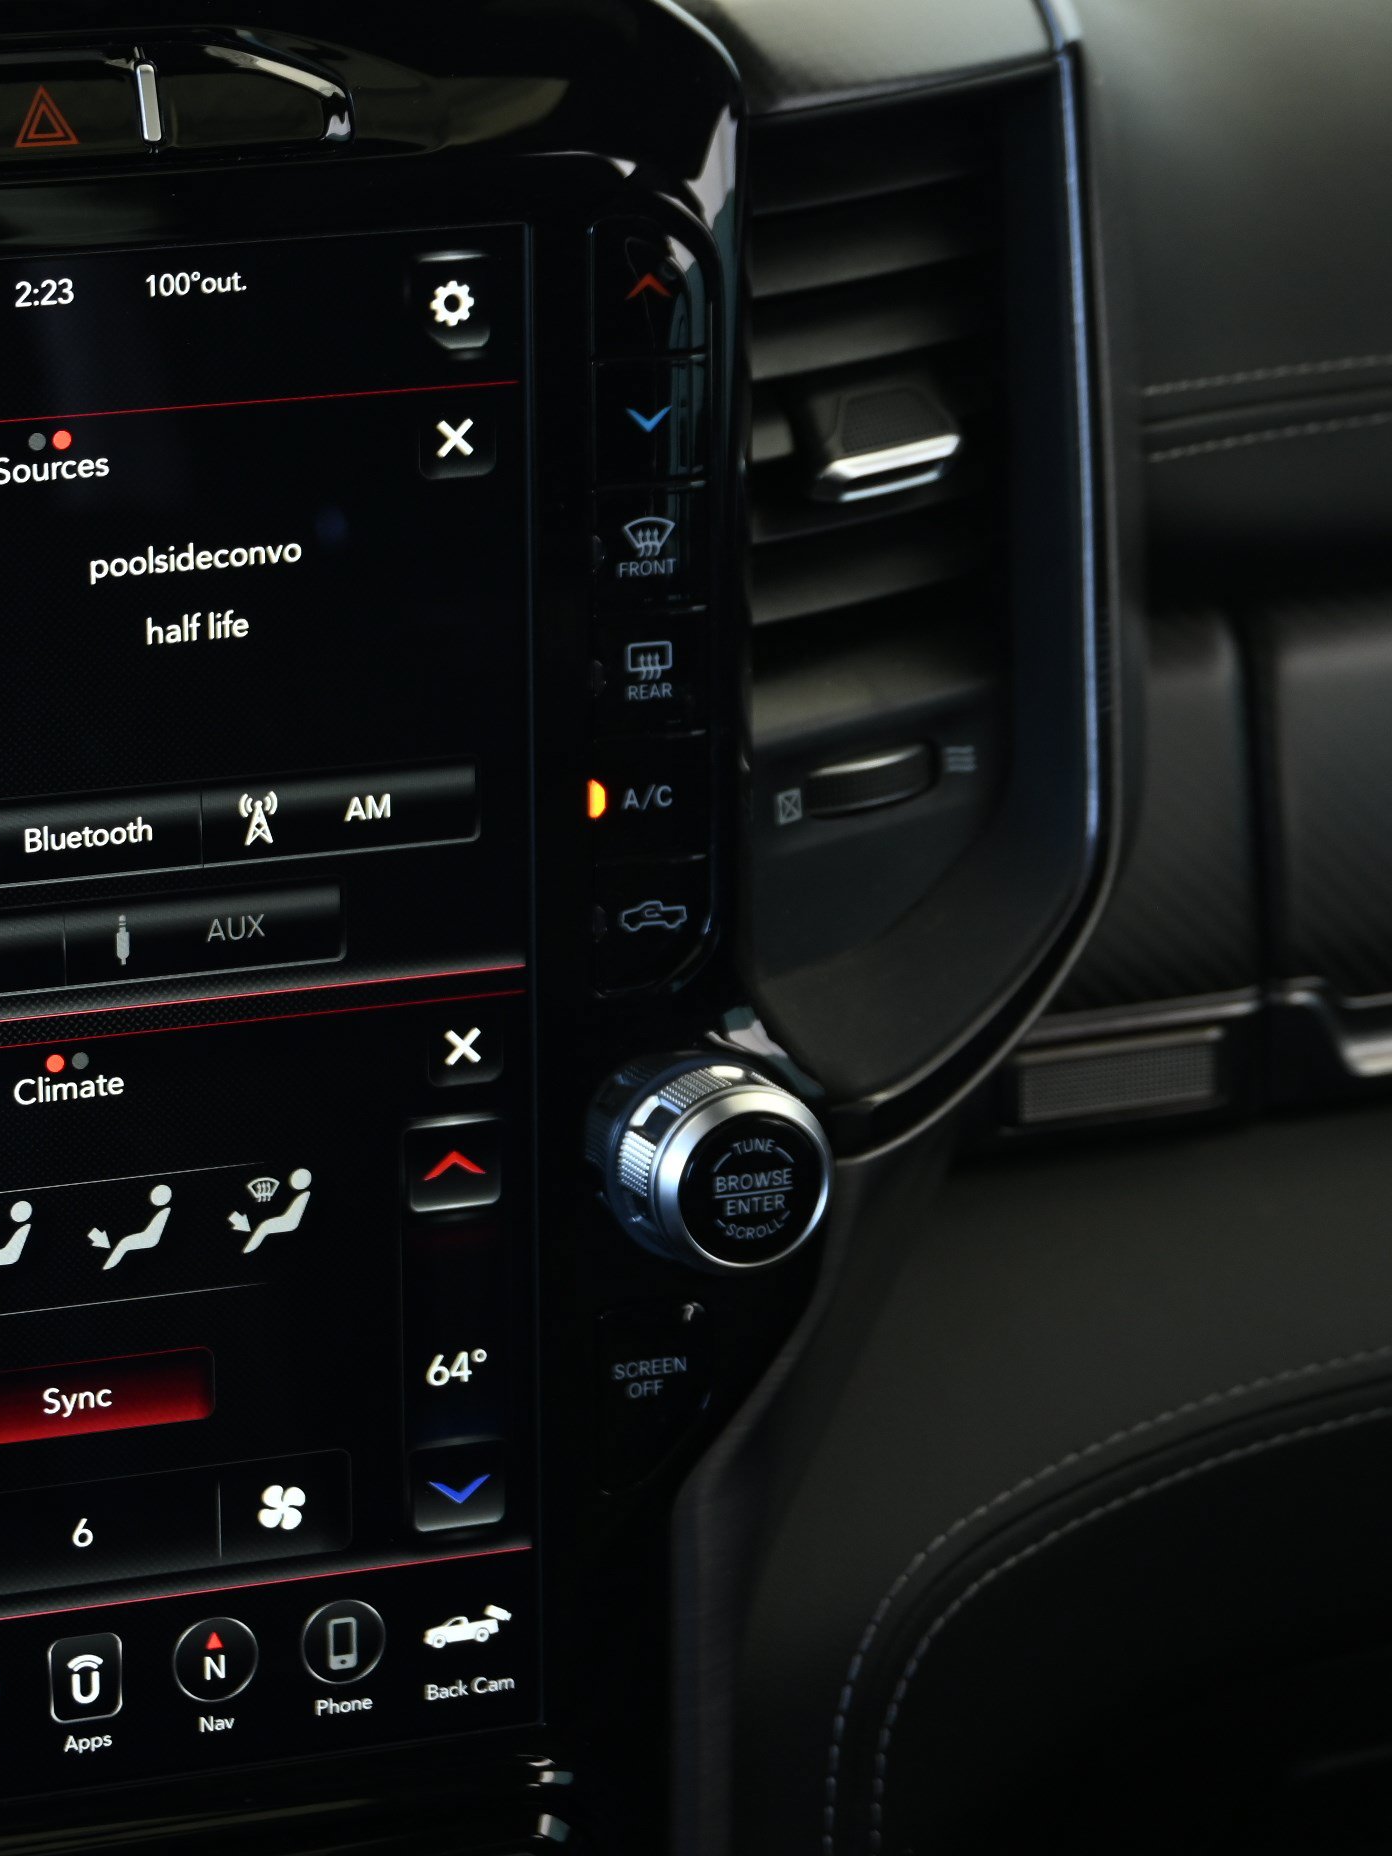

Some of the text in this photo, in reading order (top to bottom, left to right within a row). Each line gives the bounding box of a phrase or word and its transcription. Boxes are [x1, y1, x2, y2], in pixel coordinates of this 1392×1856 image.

[14, 277, 75, 308] 2:23
[89, 542, 302, 586] poolsideconvo
[617, 558, 677, 577] FRONT
[145, 609, 250, 646] half life
[627, 683, 673, 700] REAR
[344, 792, 391, 822] AM
[623, 784, 673, 810] A/C
[24, 815, 153, 854] Bluetooth
[205, 913, 266, 942] AUX
[13, 1074, 125, 1106] Climate
[733, 1138, 776, 1155] TUNE
[715, 1168, 793, 1193] BROWSE
[725, 1194, 786, 1217] ENTER
[725, 1219, 784, 1240] SCROLL
[613, 1356, 687, 1380] SCREEN
[42, 1387, 114, 1416] Sync
[628, 1379, 663, 1399] OFF
[72, 1517, 94, 1548] 6
[204, 1654, 226, 1681] N
[425, 1676, 515, 1701] Back Cam
[315, 1697, 374, 1717] Phone
[199, 1715, 235, 1733] Nav
[63, 1734, 113, 1754] Apps
